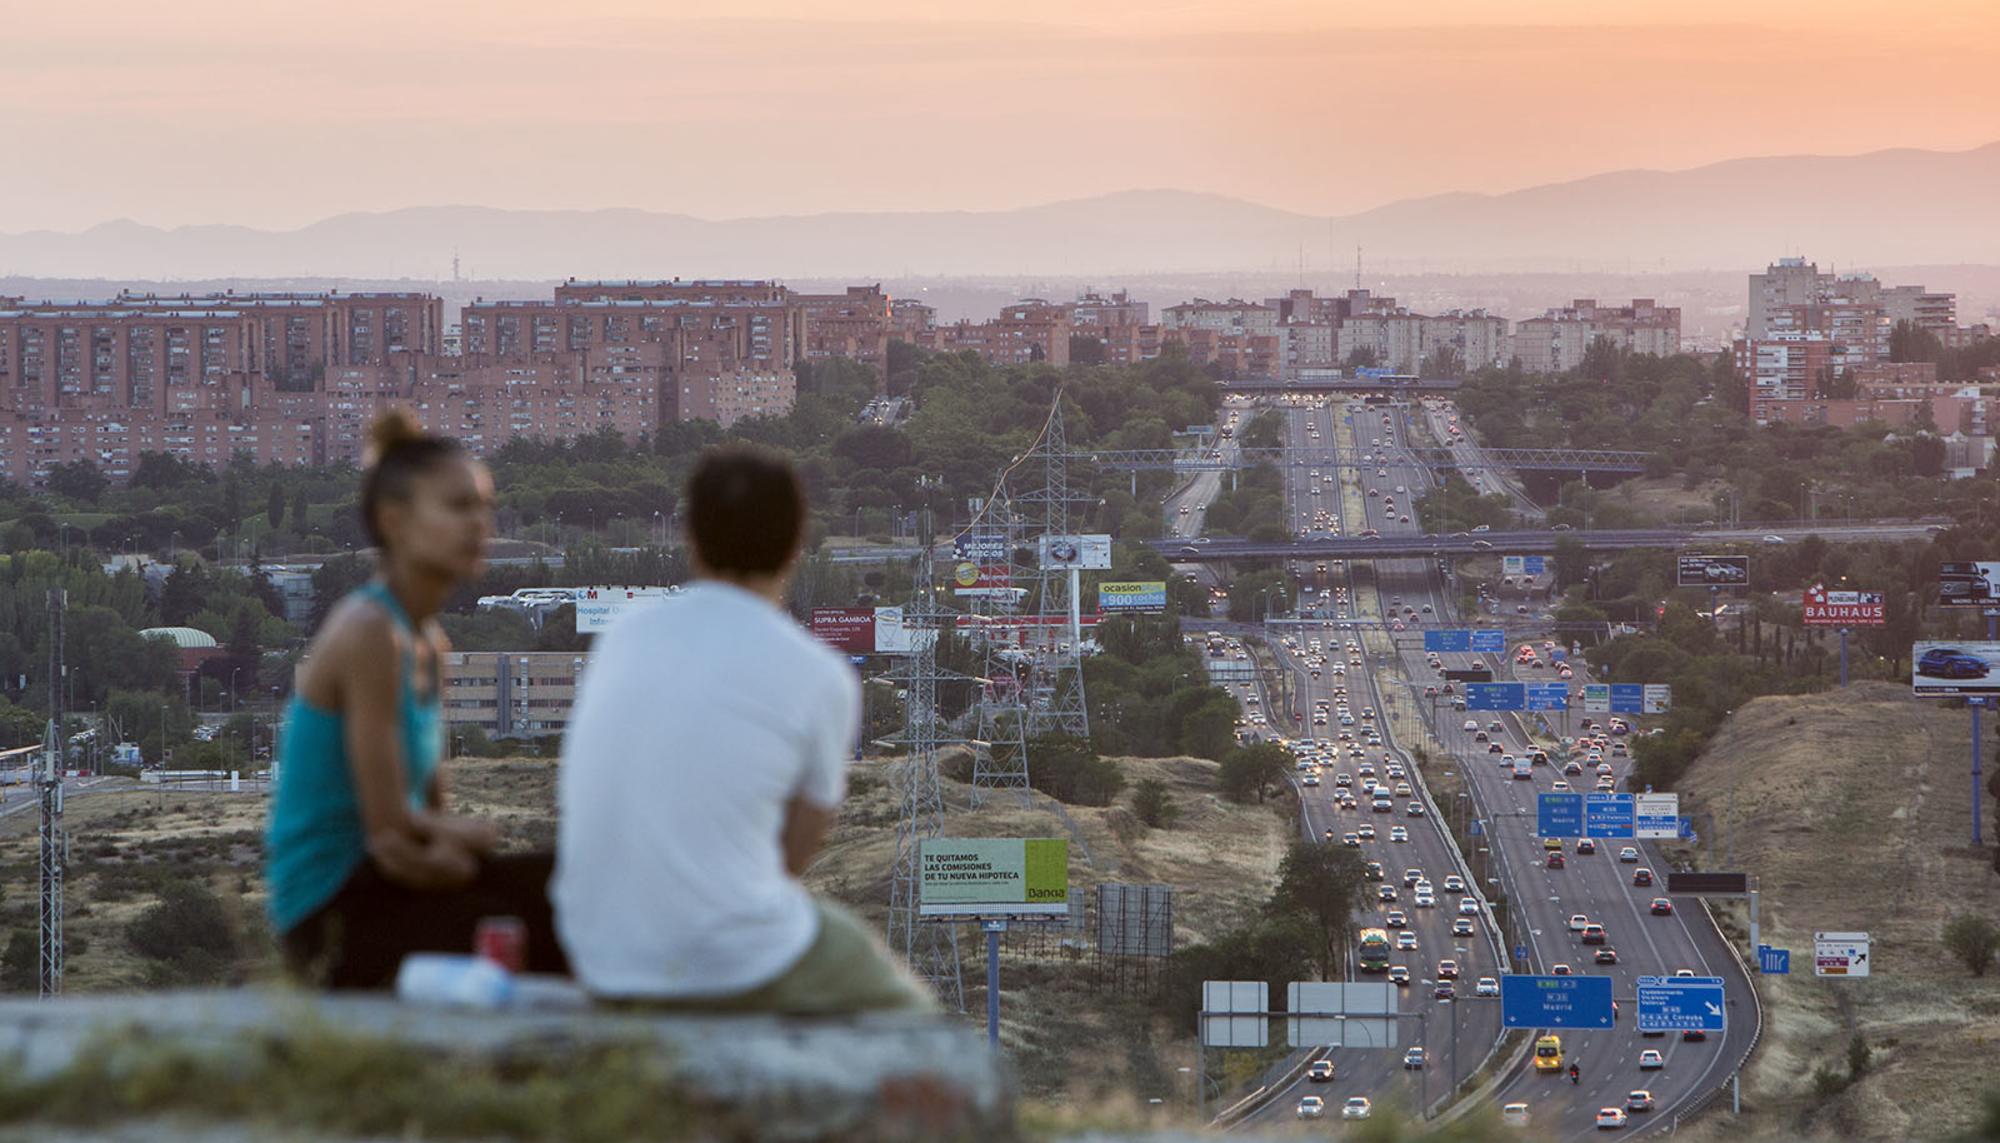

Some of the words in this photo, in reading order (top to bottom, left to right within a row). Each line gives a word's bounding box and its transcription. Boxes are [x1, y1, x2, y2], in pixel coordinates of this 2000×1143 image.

[577, 606, 609, 615] Hospital
[1806, 607, 1883, 617] BAUHAUS
[814, 616, 838, 624] SUPRA
[838, 616, 872, 624] GAMBOA
[924, 854, 935, 862] TE
[936, 853, 979, 863] QUITAMOS
[924, 863, 940, 871] LAS
[942, 862, 992, 871] COMISIONES
[938, 872, 948, 880] TU
[950, 872, 977, 880] NUEVA
[979, 871, 1019, 880] HIPOTECA
[1028, 888, 1065, 898] Bankia
[1543, 1003, 1572, 1011] Madrid
